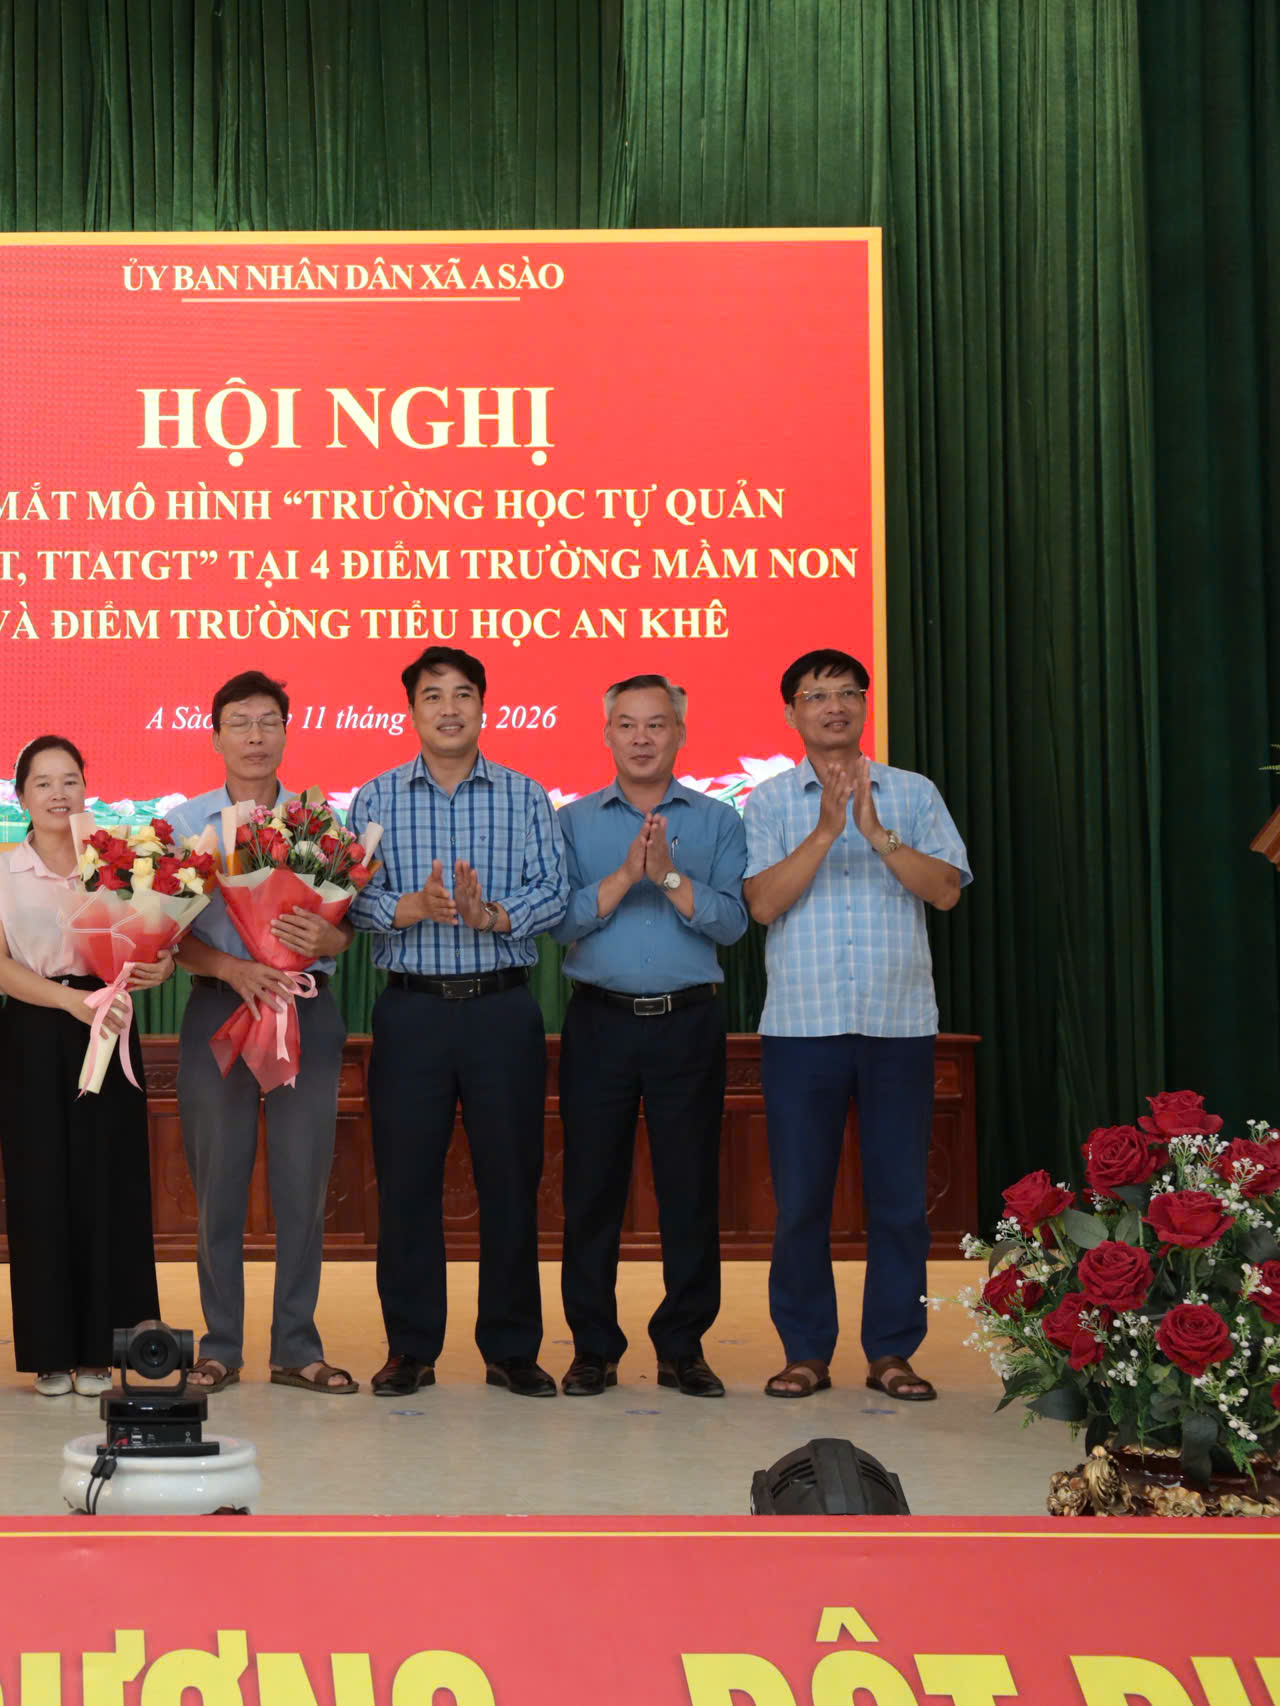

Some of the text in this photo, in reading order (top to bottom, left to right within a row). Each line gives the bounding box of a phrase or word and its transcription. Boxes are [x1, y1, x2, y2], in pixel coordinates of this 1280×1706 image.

[122, 255, 565, 292] ỦY BAN NHÂN DÂN XÃ A SÀO
[135, 376, 555, 468] HỘI NGHỊ
[86, 481, 156, 521] MÔ
[166, 481, 272, 521] HÌNH
[283, 480, 485, 520] “TRƯỜNG
[494, 488, 585, 528] HỌC
[595, 483, 658, 528] TỰ
[665, 479, 785, 526] QUẢN
[36, 549, 219, 581] TTATGT”
[228, 550, 299, 589] TẠI
[310, 549, 330, 580] 4
[340, 540, 450, 580] ĐIỂM
[460, 539, 641, 580] TRƯỜNG
[652, 538, 758, 579] MẦM
[768, 547, 858, 579] NON
[50, 600, 161, 640] ĐIỂM
[169, 599, 351, 640] TRƯỜNG
[360, 599, 459, 639] TIỂU
[470, 608, 561, 648] HỌC
[569, 608, 627, 639] AN
[639, 598, 729, 639] KHÊ
[145, 706, 164, 730] A
[301, 705, 327, 730] 11
[335, 704, 407, 736] tháng
[495, 705, 558, 729] 2026
